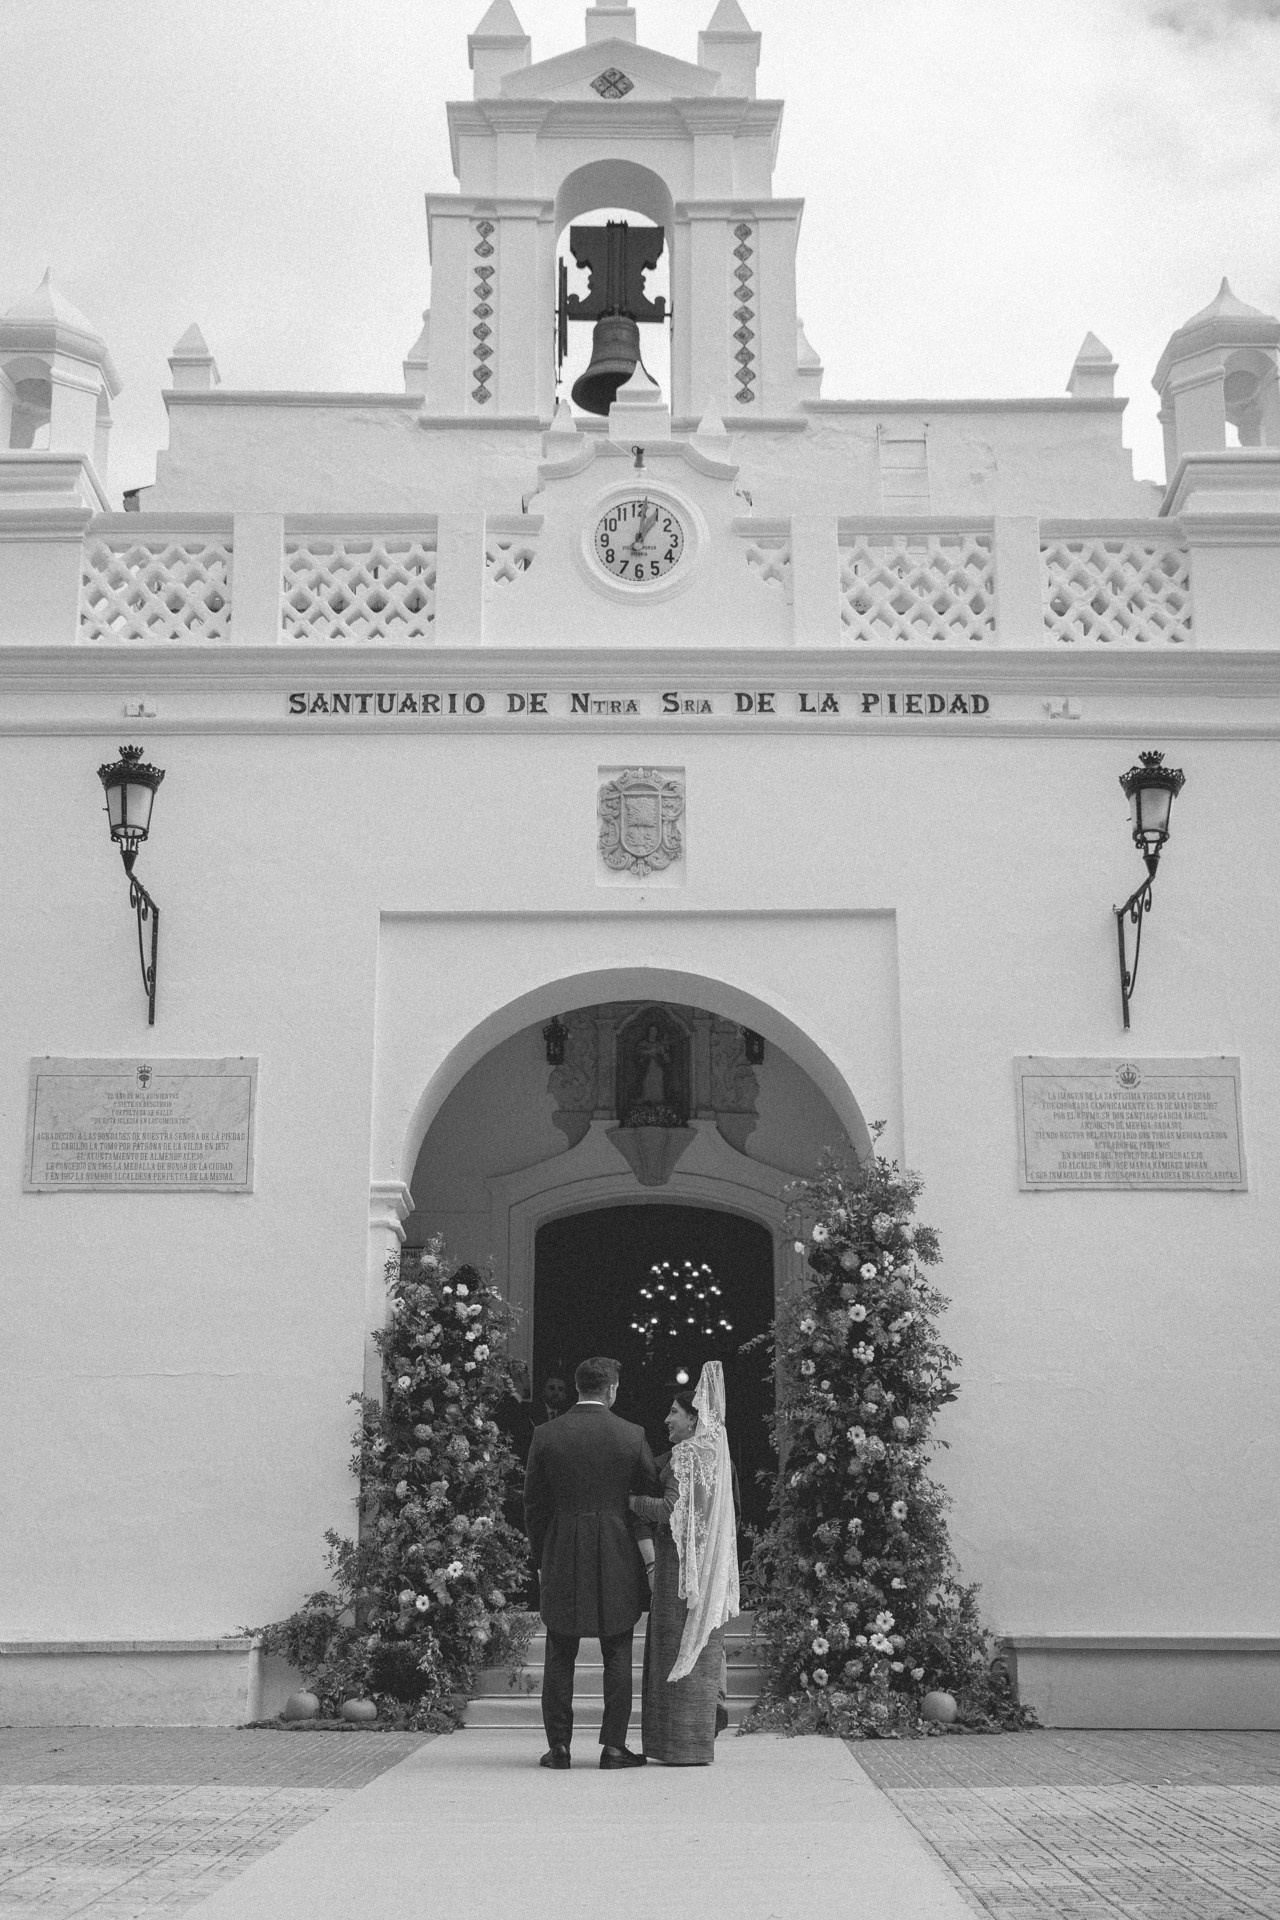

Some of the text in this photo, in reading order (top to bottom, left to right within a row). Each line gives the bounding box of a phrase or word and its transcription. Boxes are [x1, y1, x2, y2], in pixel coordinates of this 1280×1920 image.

[618, 508, 627, 521] 11
[632, 504, 647, 518] 12
[604, 518, 617, 532] 10
[663, 518, 672, 532] 2
[600, 533, 609, 547] 9
[670, 534, 678, 548] 3
[606, 549, 615, 563] 8
[664, 549, 675, 563] 4
[619, 560, 629, 574] 7
[635, 564, 644, 579] 6
[650, 561, 660, 576] 5
[288, 692, 485, 714] SANTUARIO
[507, 692, 548, 714] DE
[734, 692, 776, 714] DE
[798, 692, 841, 714] LA
[861, 692, 990, 714] PIEDAD
[132, 1132, 141, 1140] DE
[142, 1132, 172, 1140] NUESTRA
[175, 1132, 200, 1140] SEÑORA
[202, 1132, 210, 1140] DE
[211, 1132, 220, 1140] LA
[222, 1132, 245, 1140] PIEDAD
[88, 1162, 96, 1170] EN
[113, 1162, 122, 1170] LA
[123, 1162, 155, 1170] MEDALLA
[157, 1162, 166, 1170] DE
[189, 1162, 197, 1170] DE
[199, 1162, 208, 1170] LA
[209, 1162, 233, 1170] CIUDAD
